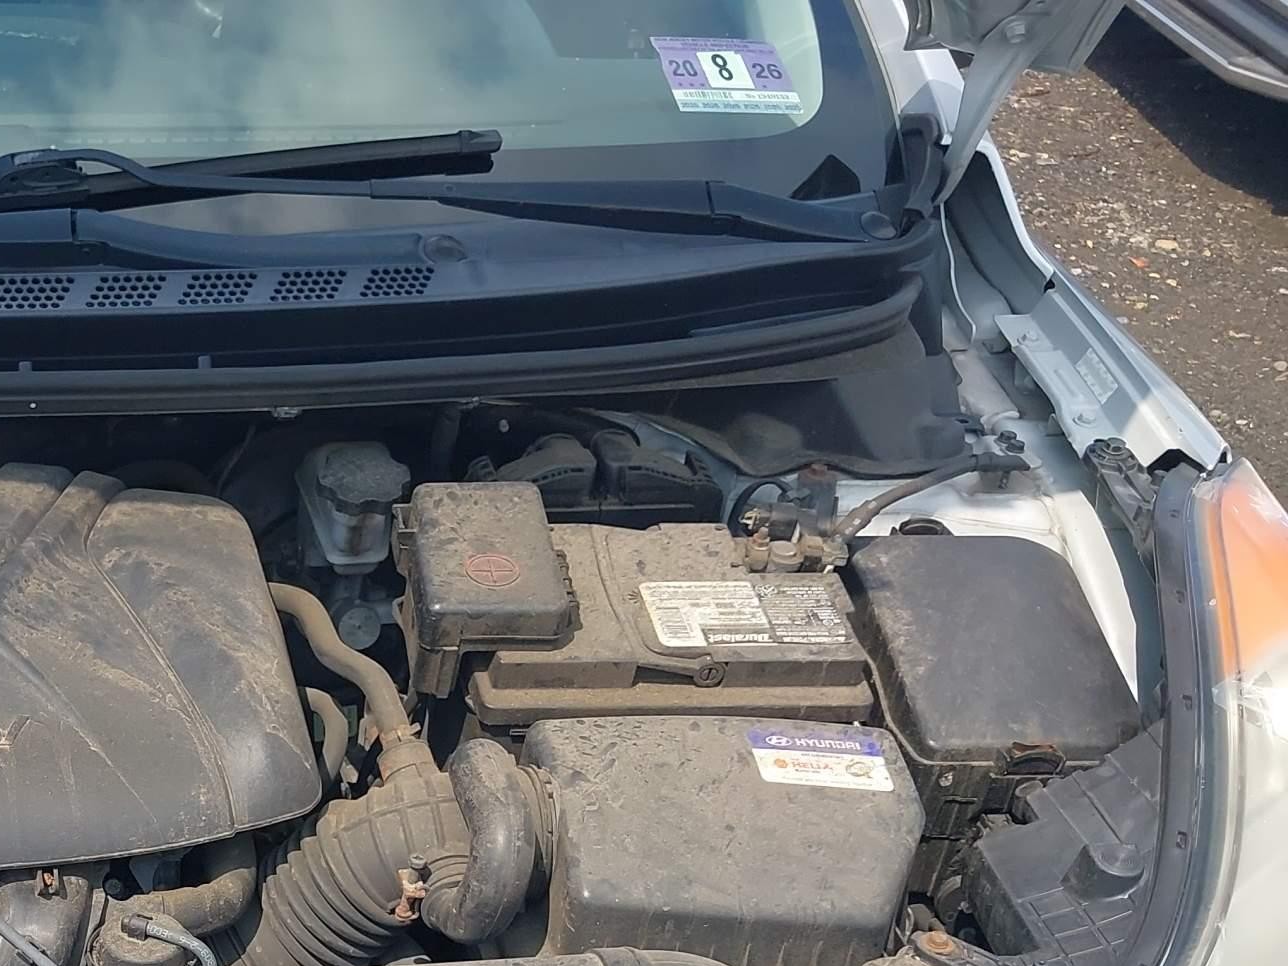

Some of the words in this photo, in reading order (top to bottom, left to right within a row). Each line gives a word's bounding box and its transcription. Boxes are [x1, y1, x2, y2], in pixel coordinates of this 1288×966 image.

[668, 59, 698, 77] 20
[711, 53, 734, 81] 8
[751, 63, 783, 80] 26
[707, 633, 774, 642] Duralast
[795, 737, 861, 751] HYUNDAI
